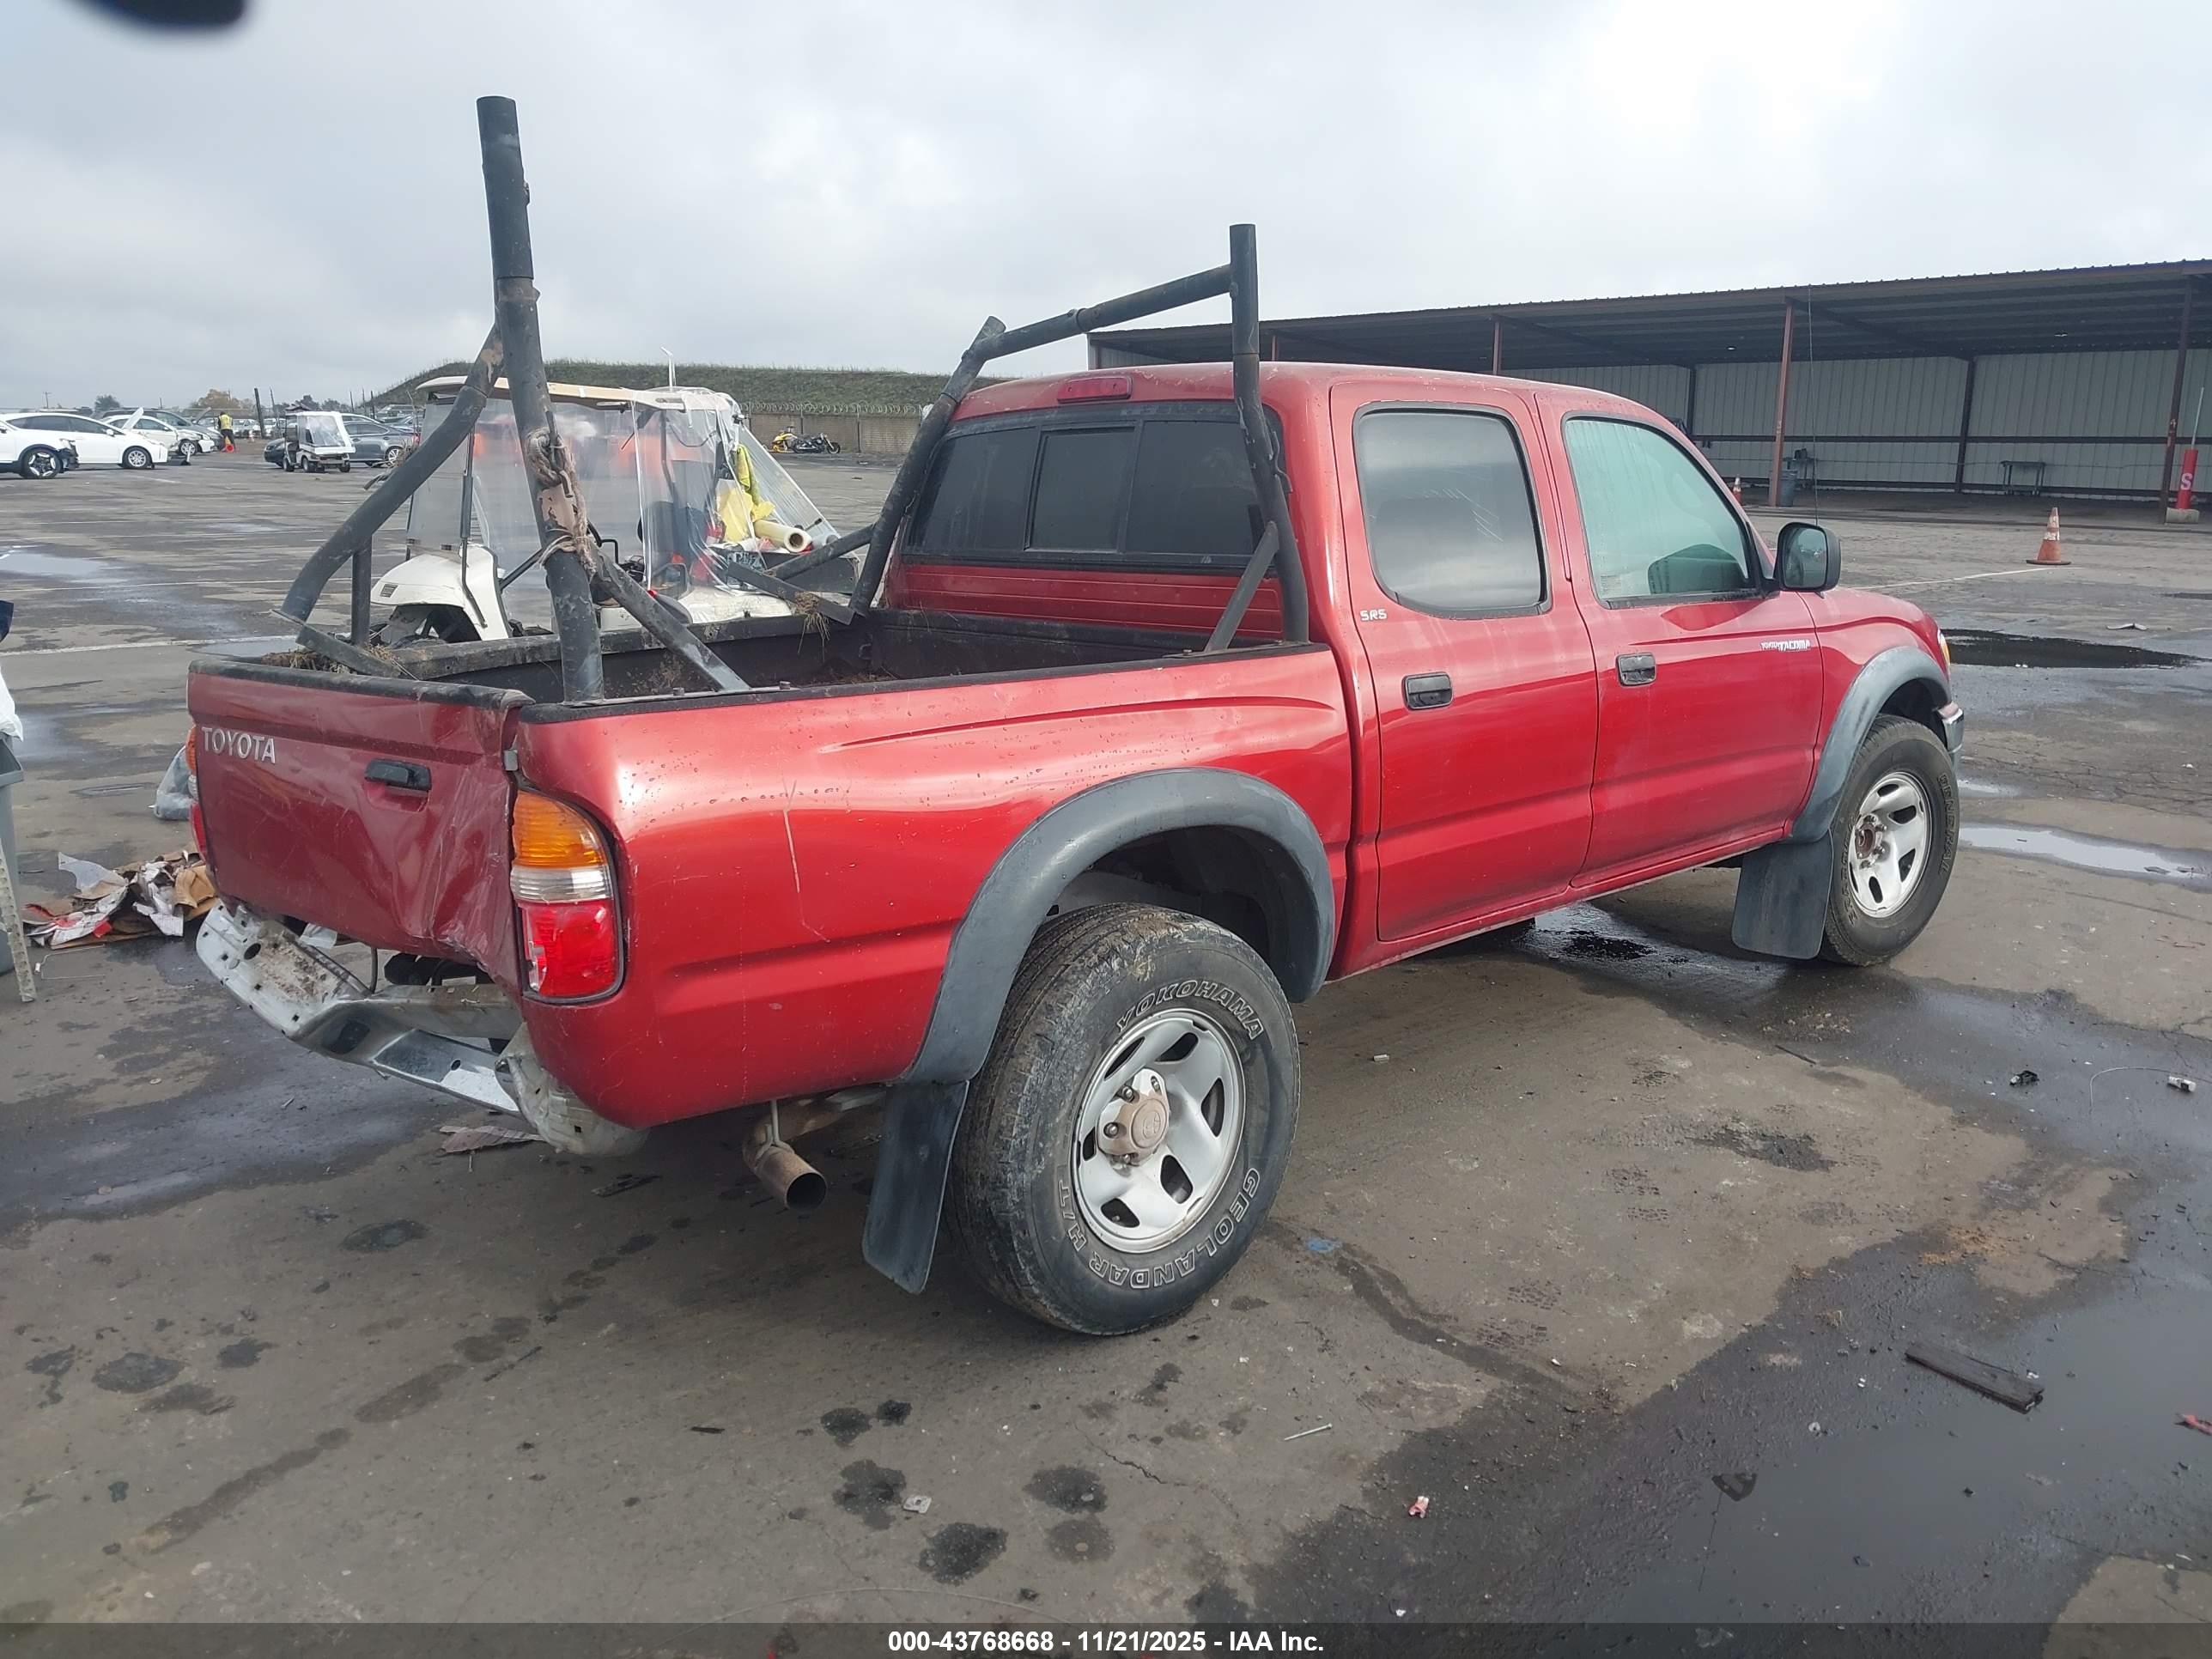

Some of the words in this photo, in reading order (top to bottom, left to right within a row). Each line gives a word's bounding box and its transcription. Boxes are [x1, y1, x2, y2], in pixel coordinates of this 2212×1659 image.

[2180, 472, 2193, 490] S
[202, 726, 276, 764] TOYOTA
[1116, 980, 1264, 1040] YOKOHAMA
[1088, 1168, 1261, 1289] GEOLANDAR
